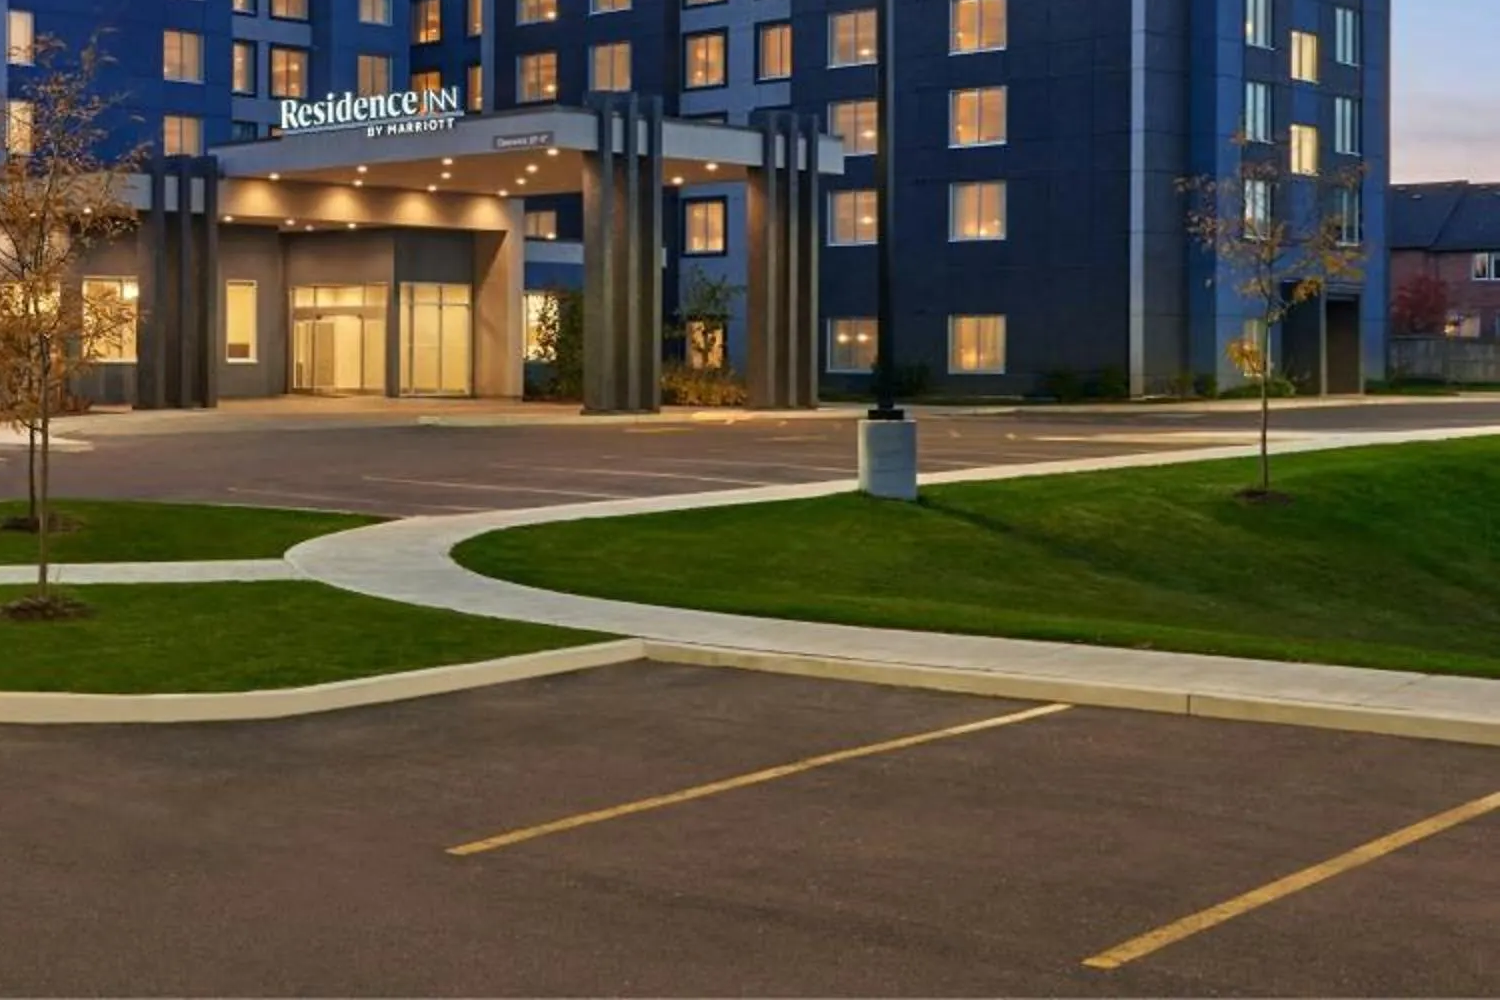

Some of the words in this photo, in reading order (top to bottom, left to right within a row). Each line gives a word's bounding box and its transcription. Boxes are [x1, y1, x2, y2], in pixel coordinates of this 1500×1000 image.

[280, 91, 418, 129] Residence
[423, 85, 457, 113] INN
[367, 124, 383, 137] BY
[387, 117, 455, 136] MARRIOTT
